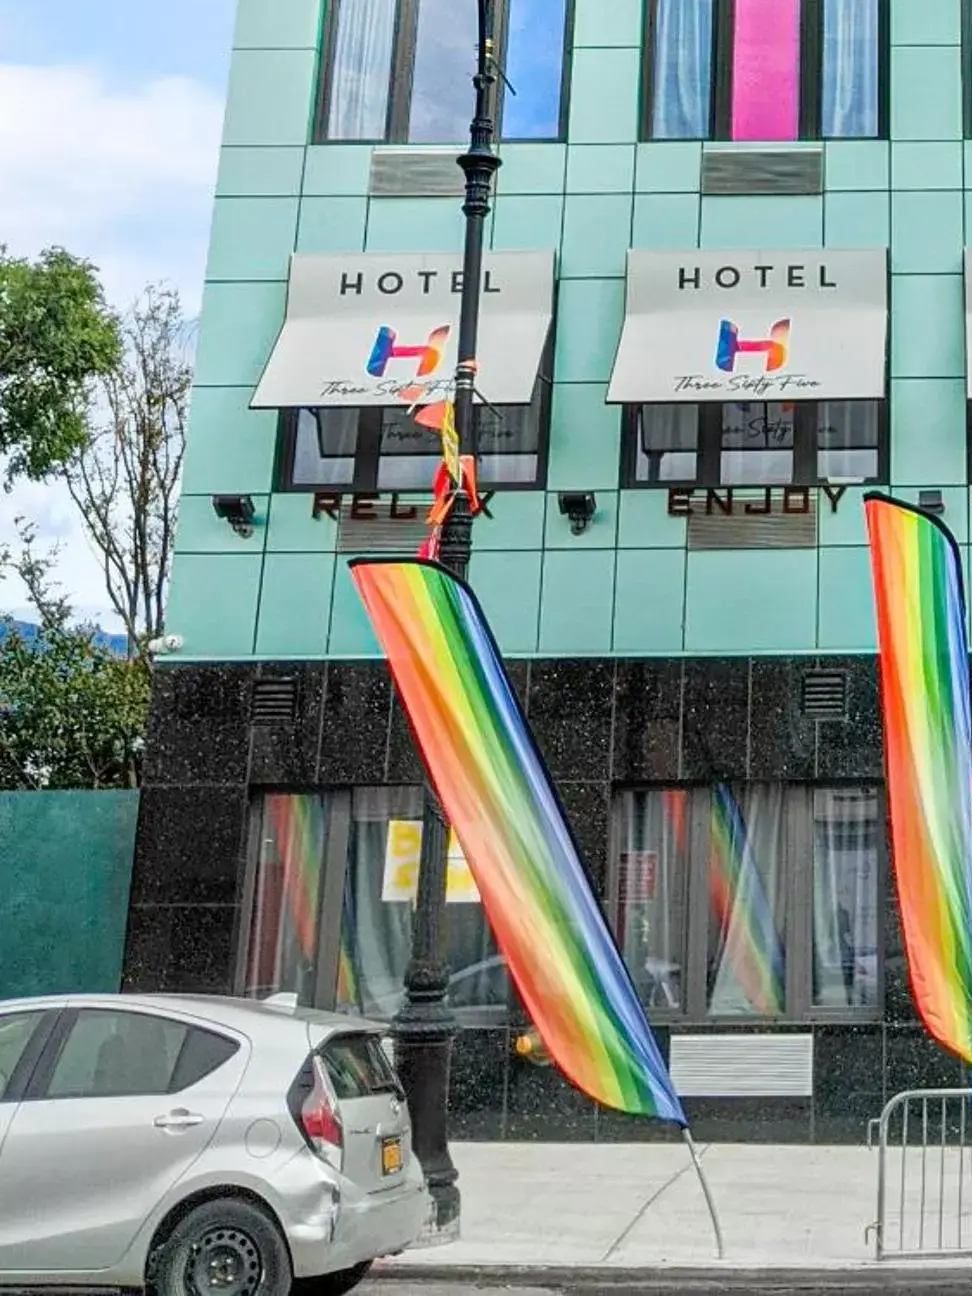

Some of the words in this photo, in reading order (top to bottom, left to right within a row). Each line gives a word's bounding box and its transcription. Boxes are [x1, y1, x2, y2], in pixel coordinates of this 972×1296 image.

[340, 270, 501, 296] HOTEL
[678, 265, 837, 290] HOTEL
[366, 324, 452, 378] H
[715, 316, 791, 373] H
[320, 379, 369, 398] Three
[673, 375, 723, 392] Three
[727, 373, 776, 395] Sixty
[777, 373, 822, 390] Five
[311, 492, 496, 520] RELX
[667, 485, 847, 516] ENJOY
